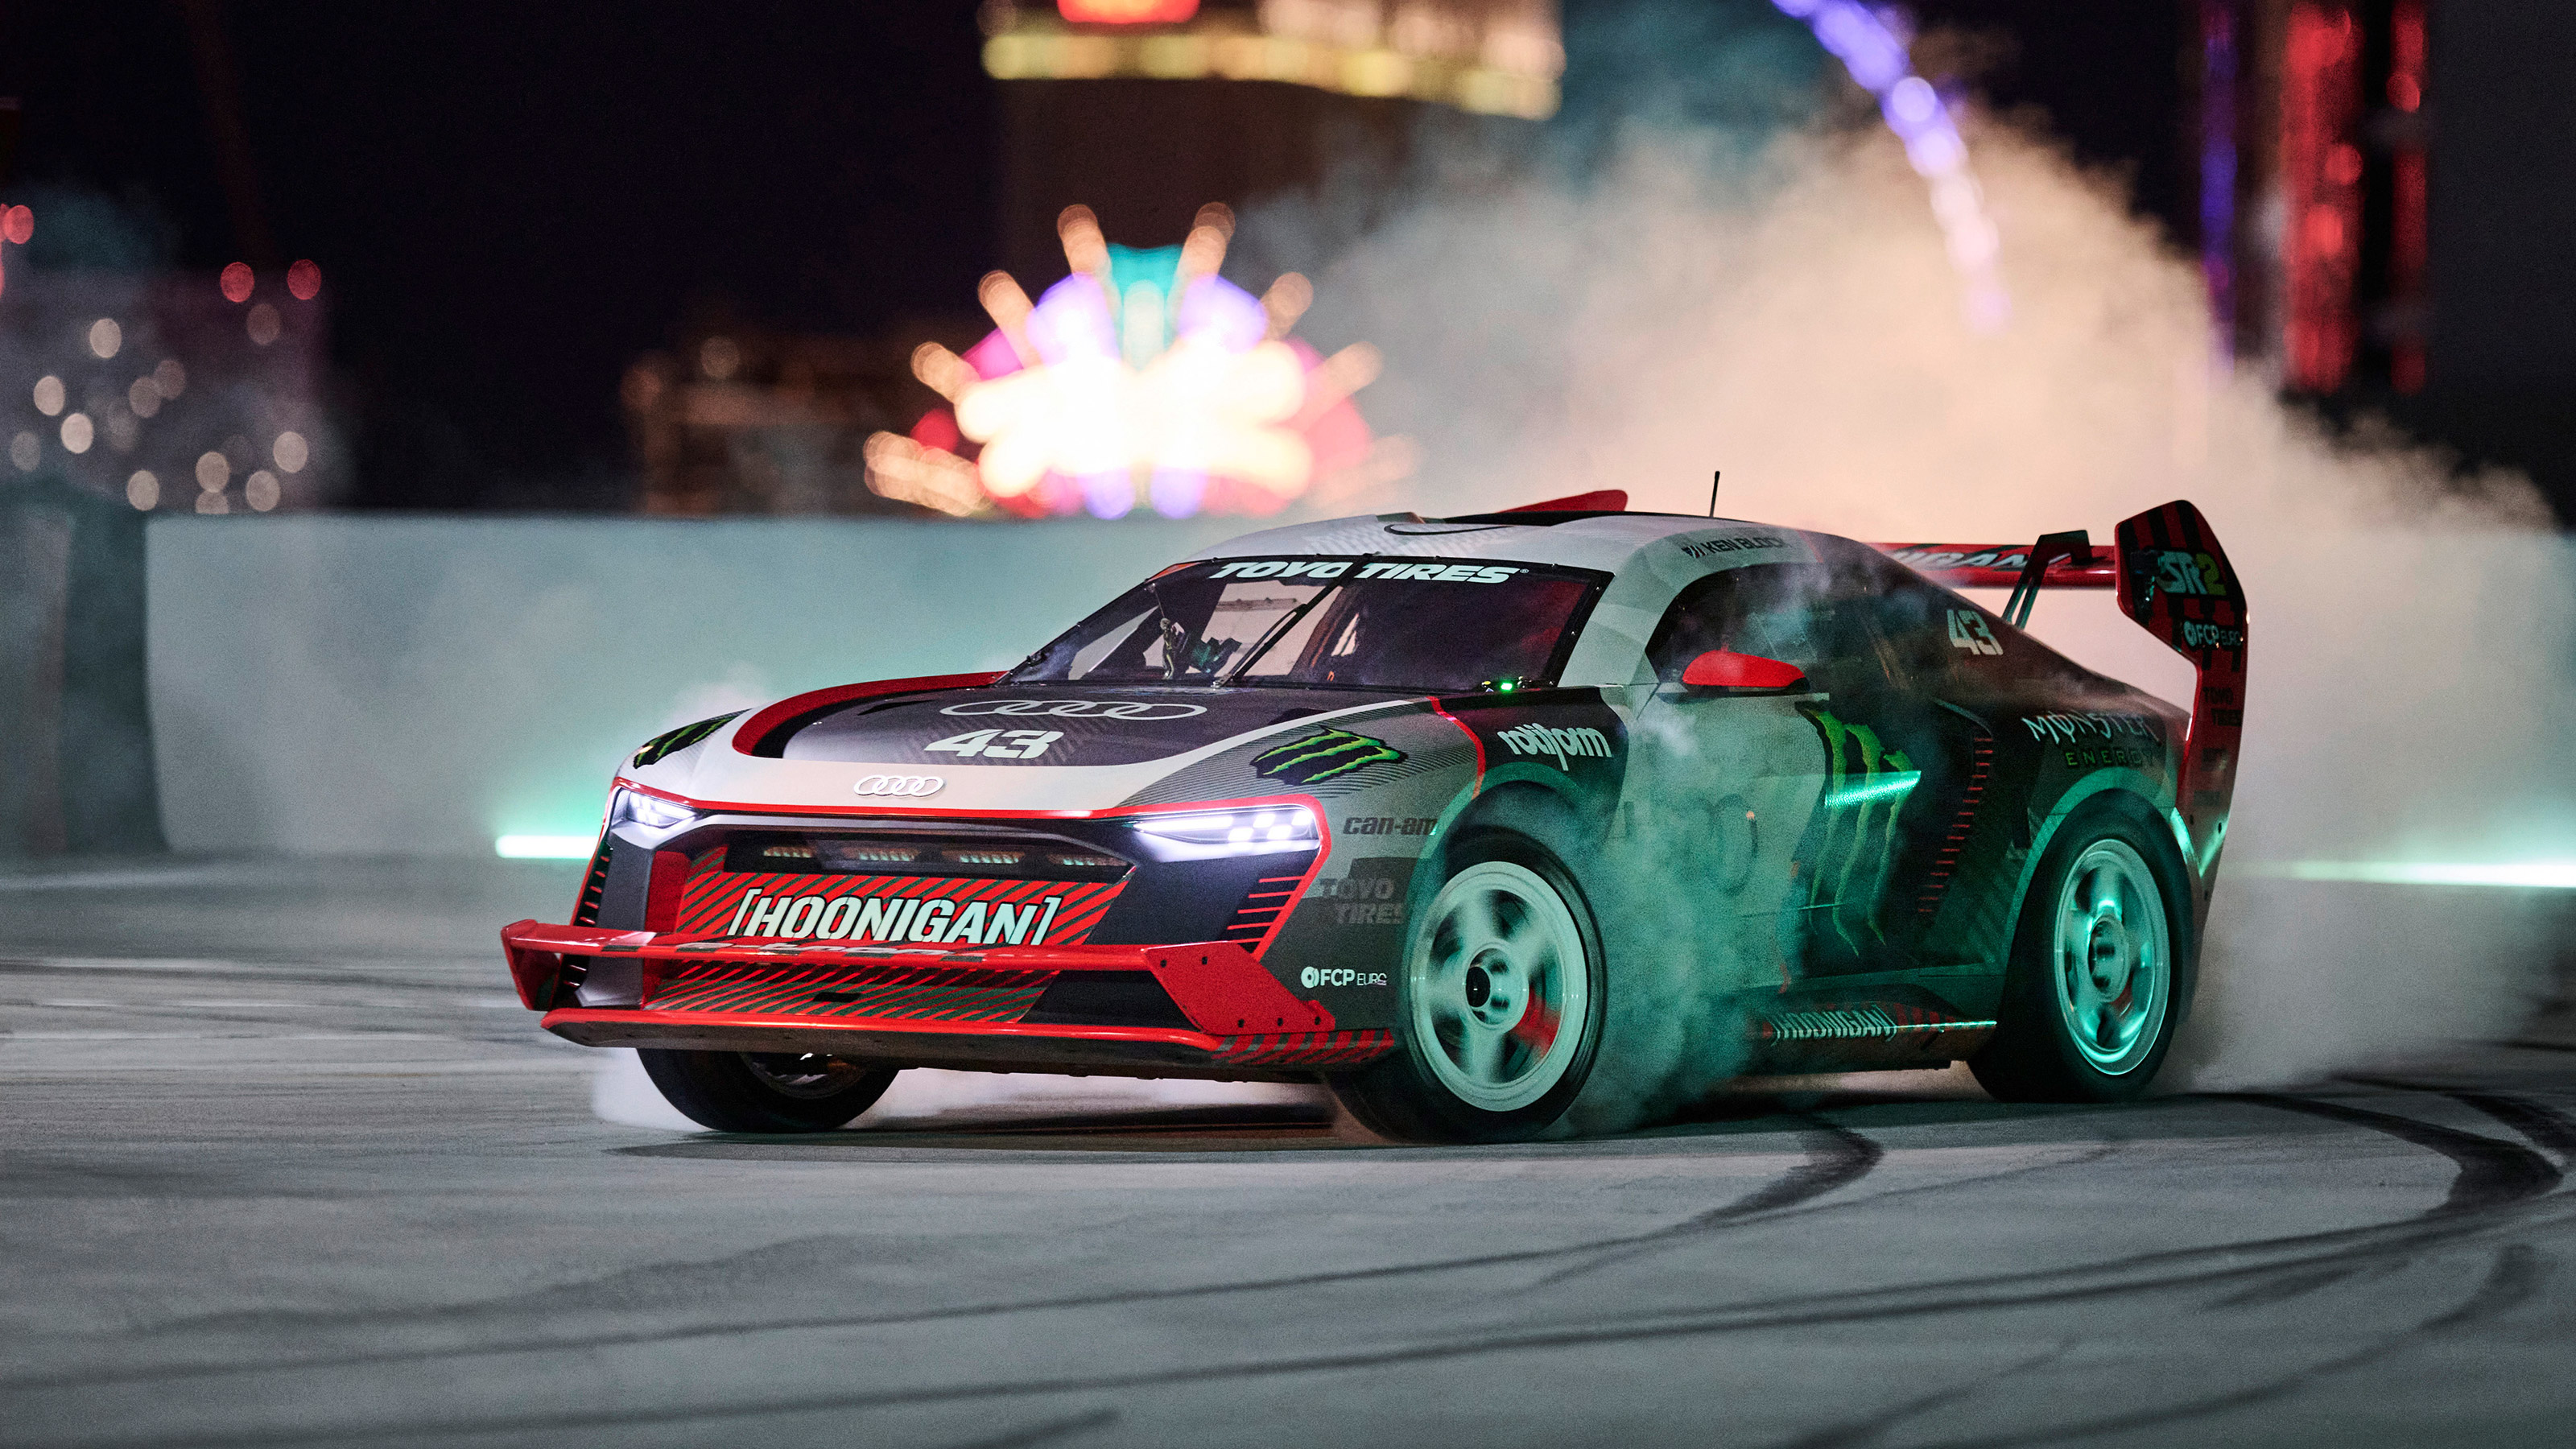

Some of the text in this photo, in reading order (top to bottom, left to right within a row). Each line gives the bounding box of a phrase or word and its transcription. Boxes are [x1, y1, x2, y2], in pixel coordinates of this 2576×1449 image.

[1700, 538, 1742, 554] KEN
[1208, 562, 1345, 579] TOYO
[1946, 609, 2004, 656] 43
[2195, 623, 2220, 646] FCP
[923, 729, 1065, 759] 43
[1496, 722, 1612, 771] rotiform
[1343, 816, 1439, 836] can-am
[727, 888, 1062, 946] [HOONIGAN]
[1320, 968, 1356, 987] FCP
